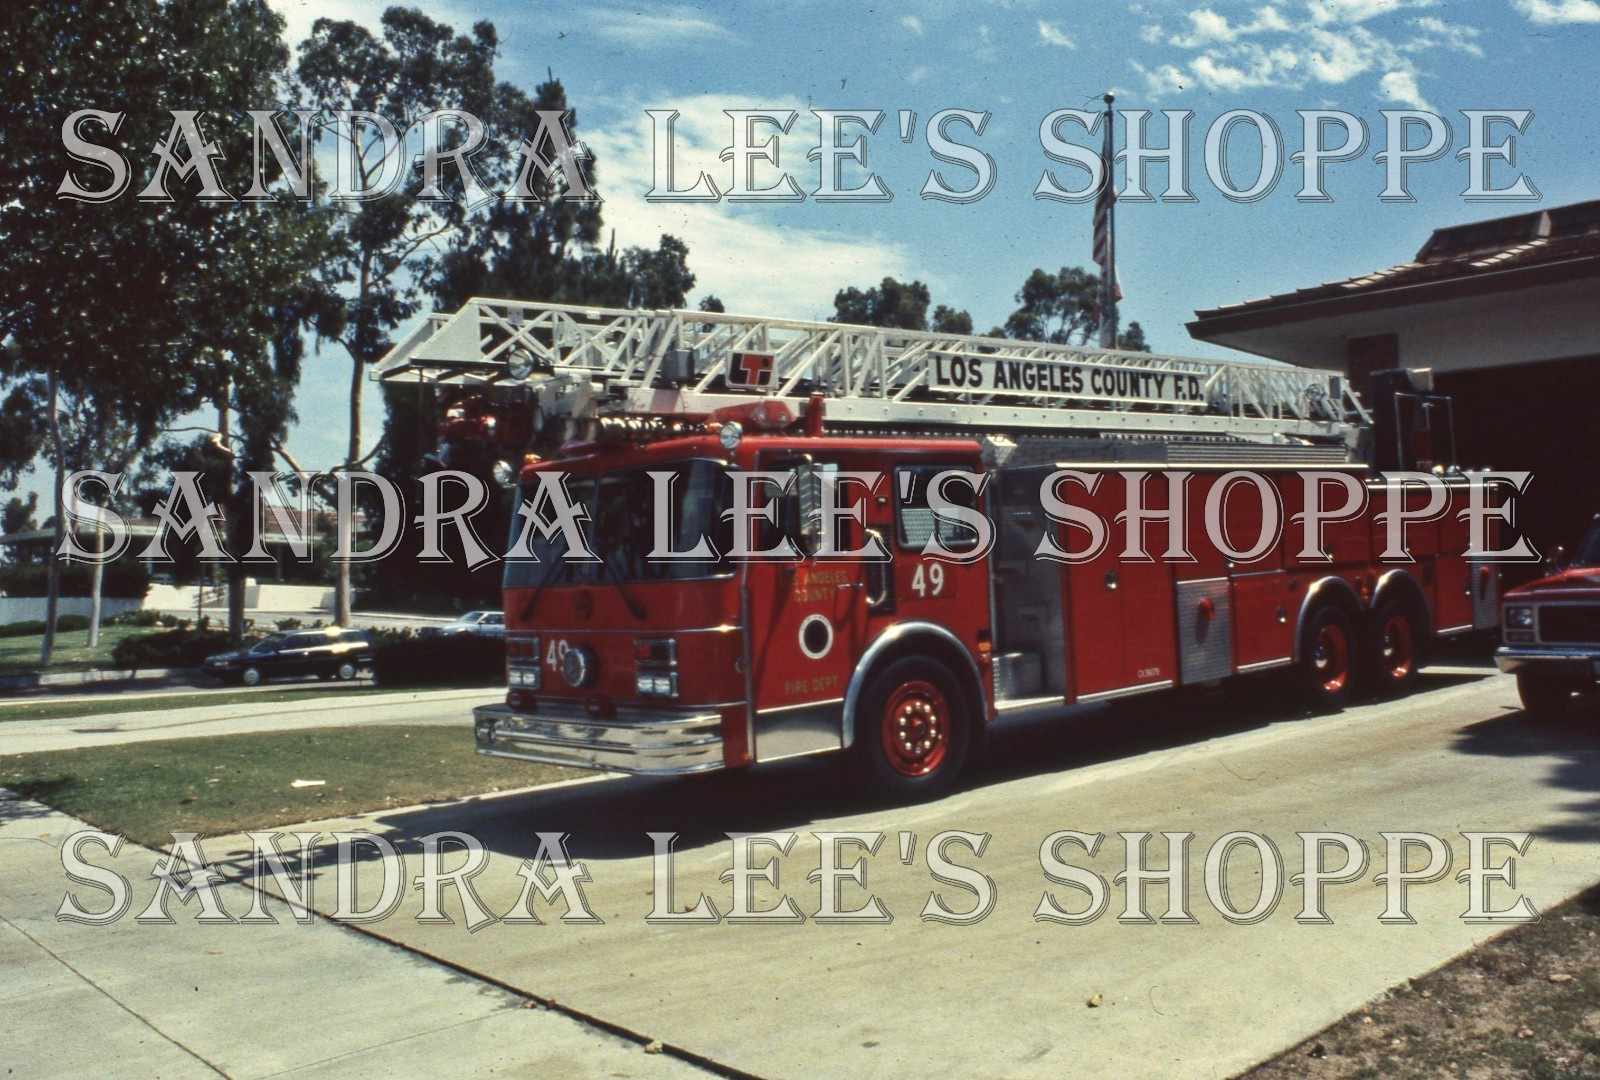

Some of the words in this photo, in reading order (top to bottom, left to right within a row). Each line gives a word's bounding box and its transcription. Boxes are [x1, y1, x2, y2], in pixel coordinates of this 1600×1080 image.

[935, 355, 983, 388] LOS
[993, 361, 1084, 394] ANGELES
[1091, 368, 1166, 399] COUNTY
[1173, 373, 1205, 401] F.D.
[911, 563, 944, 597] 49
[794, 587, 836, 602] COUNTY
[784, 679, 808, 694] FIRE
